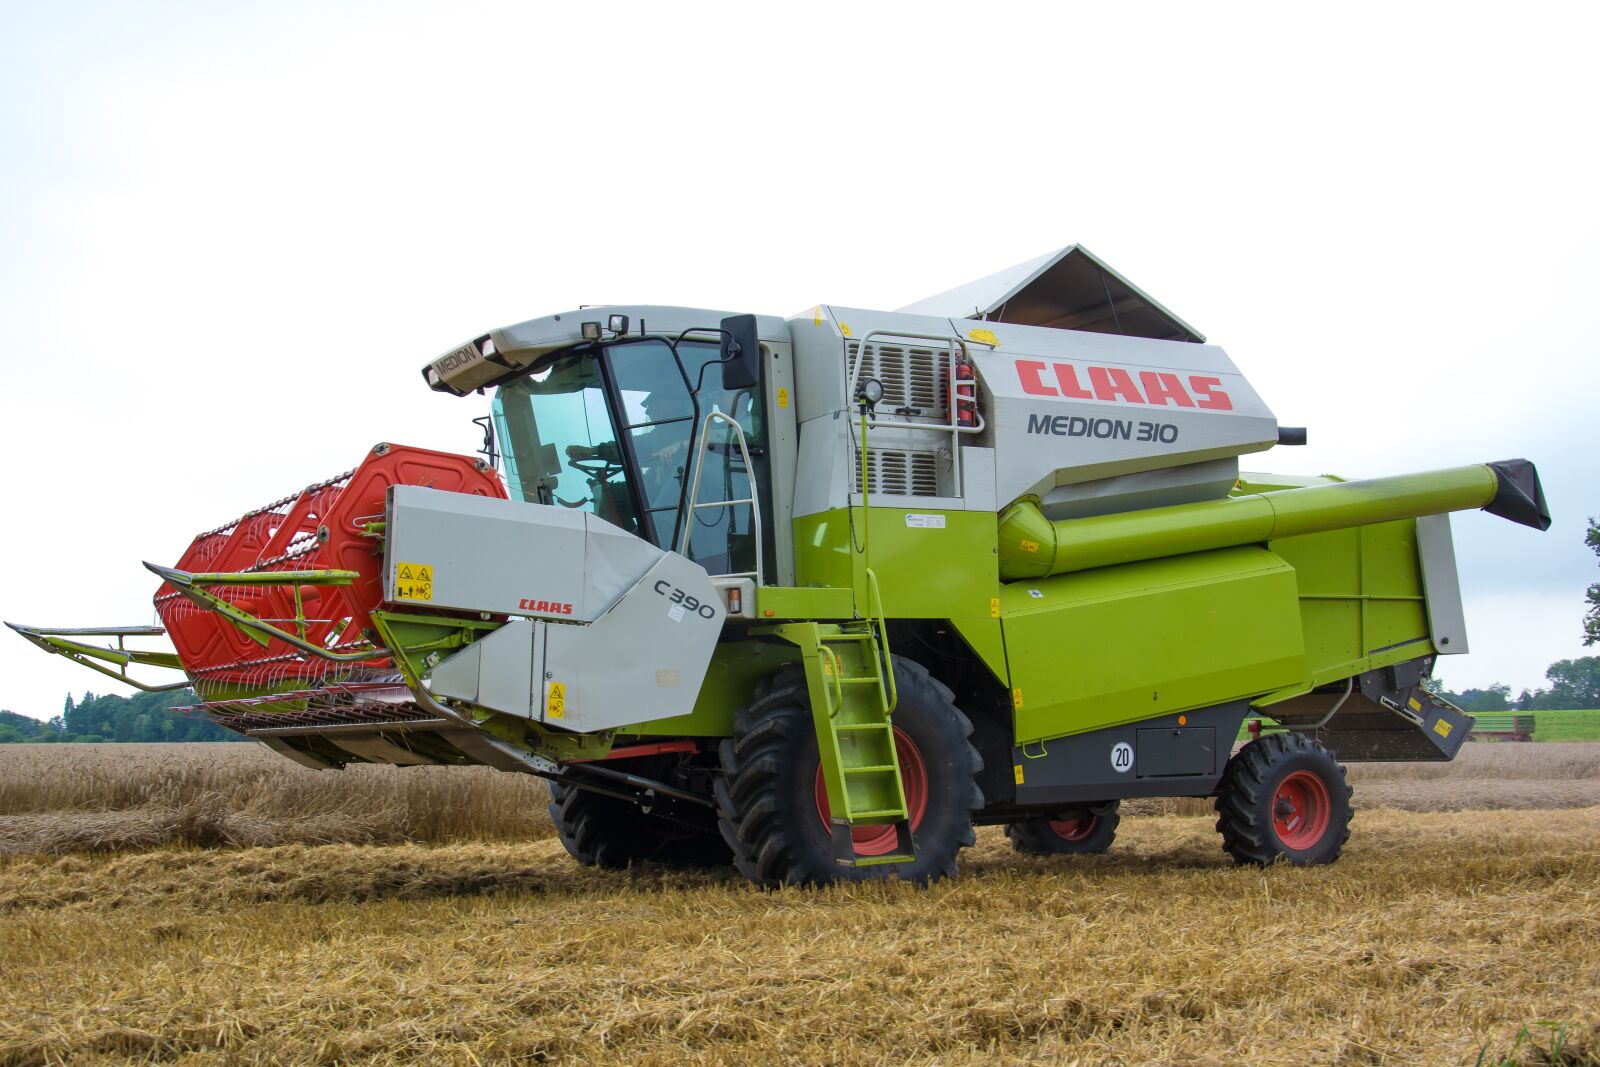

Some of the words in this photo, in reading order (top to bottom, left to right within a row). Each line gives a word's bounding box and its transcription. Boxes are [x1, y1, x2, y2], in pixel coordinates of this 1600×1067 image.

[436, 346, 476, 376] MEDION
[1015, 359, 1233, 411] CLAAS
[1027, 414, 1132, 440] MEDION
[1136, 421, 1179, 444] 310
[518, 598, 573, 615] CLAAS
[654, 579, 671, 596] C
[668, 588, 716, 619] 390
[1115, 747, 1129, 767] 20
